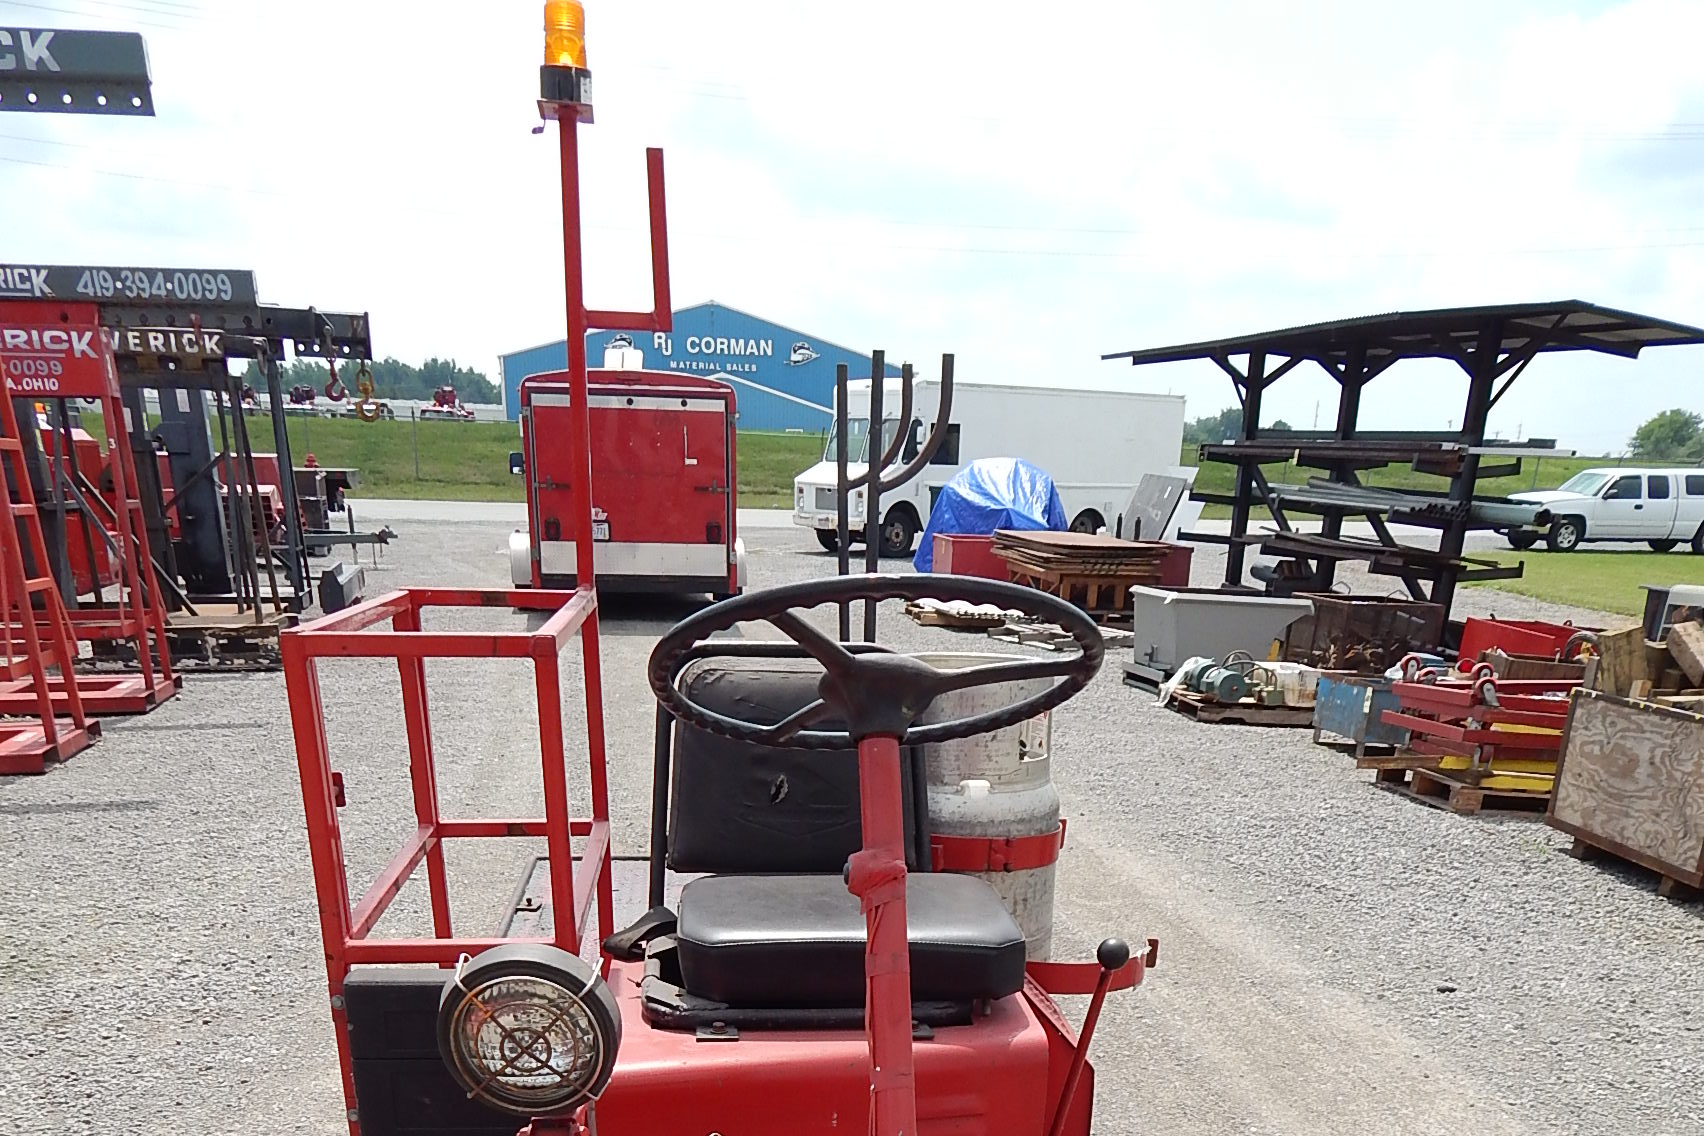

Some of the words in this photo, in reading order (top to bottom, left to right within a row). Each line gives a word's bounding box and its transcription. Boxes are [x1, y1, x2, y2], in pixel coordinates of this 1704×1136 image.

[0, 329, 98, 358] RICK
[686, 336, 773, 356] CORMAN
[670, 360, 721, 371] MATERIAL
[726, 363, 757, 372] SALES
